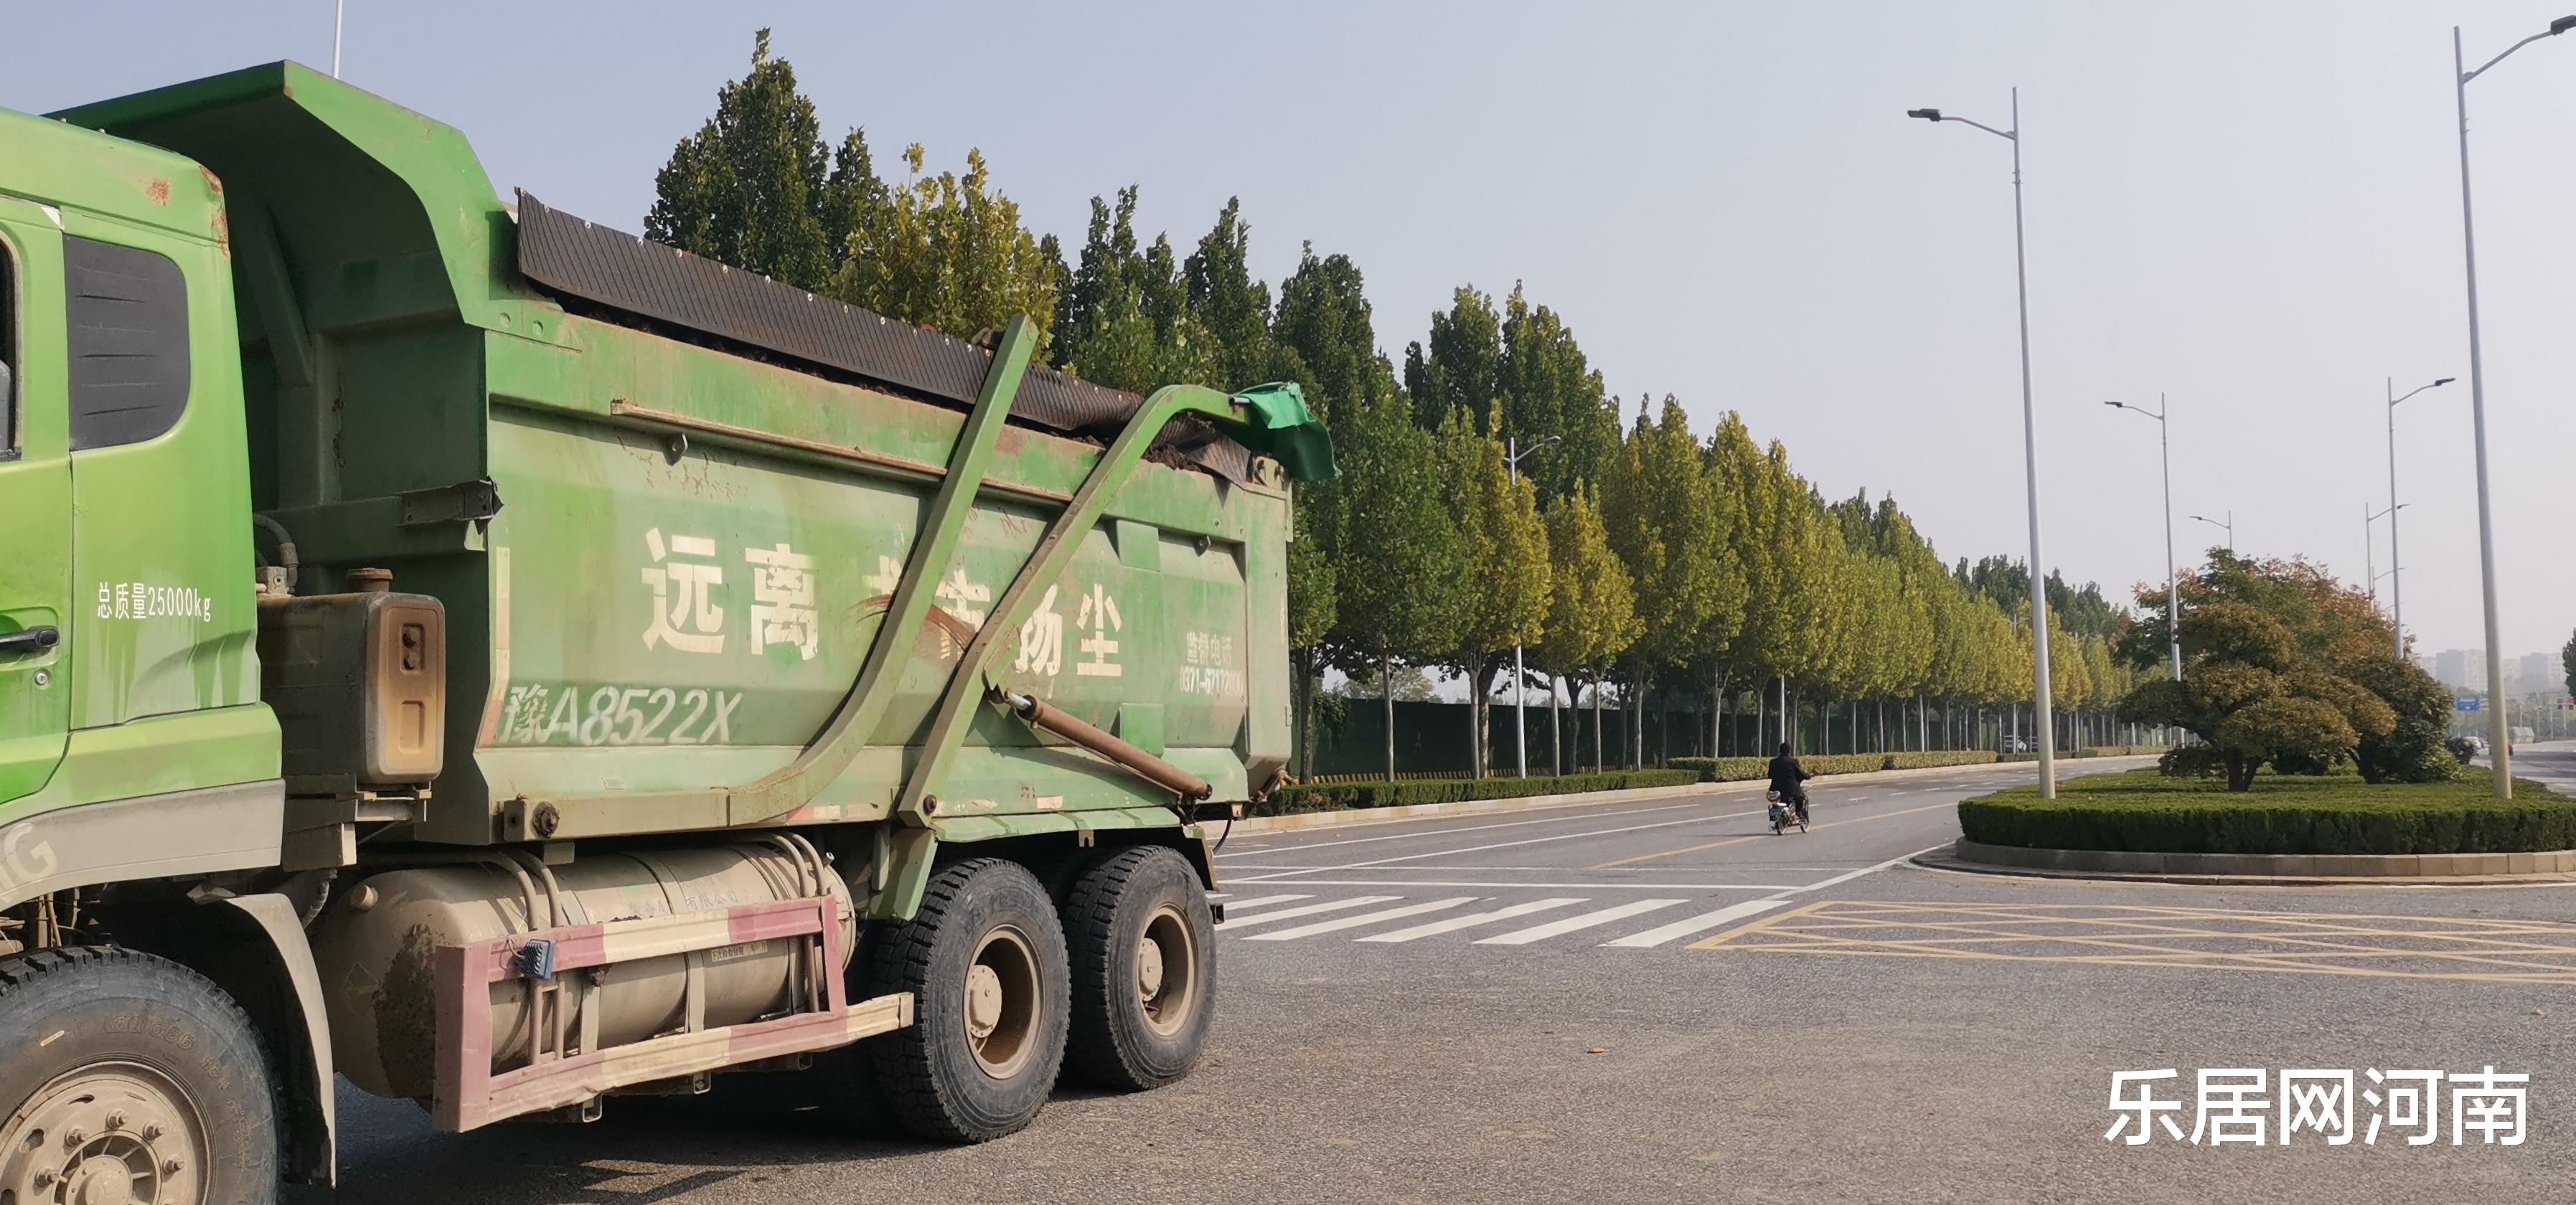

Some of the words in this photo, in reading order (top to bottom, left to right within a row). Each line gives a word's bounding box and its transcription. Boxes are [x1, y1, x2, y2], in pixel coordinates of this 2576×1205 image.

[98, 581, 211, 623] 总质量25000kg
[498, 684, 744, 745] 豫A8522X
